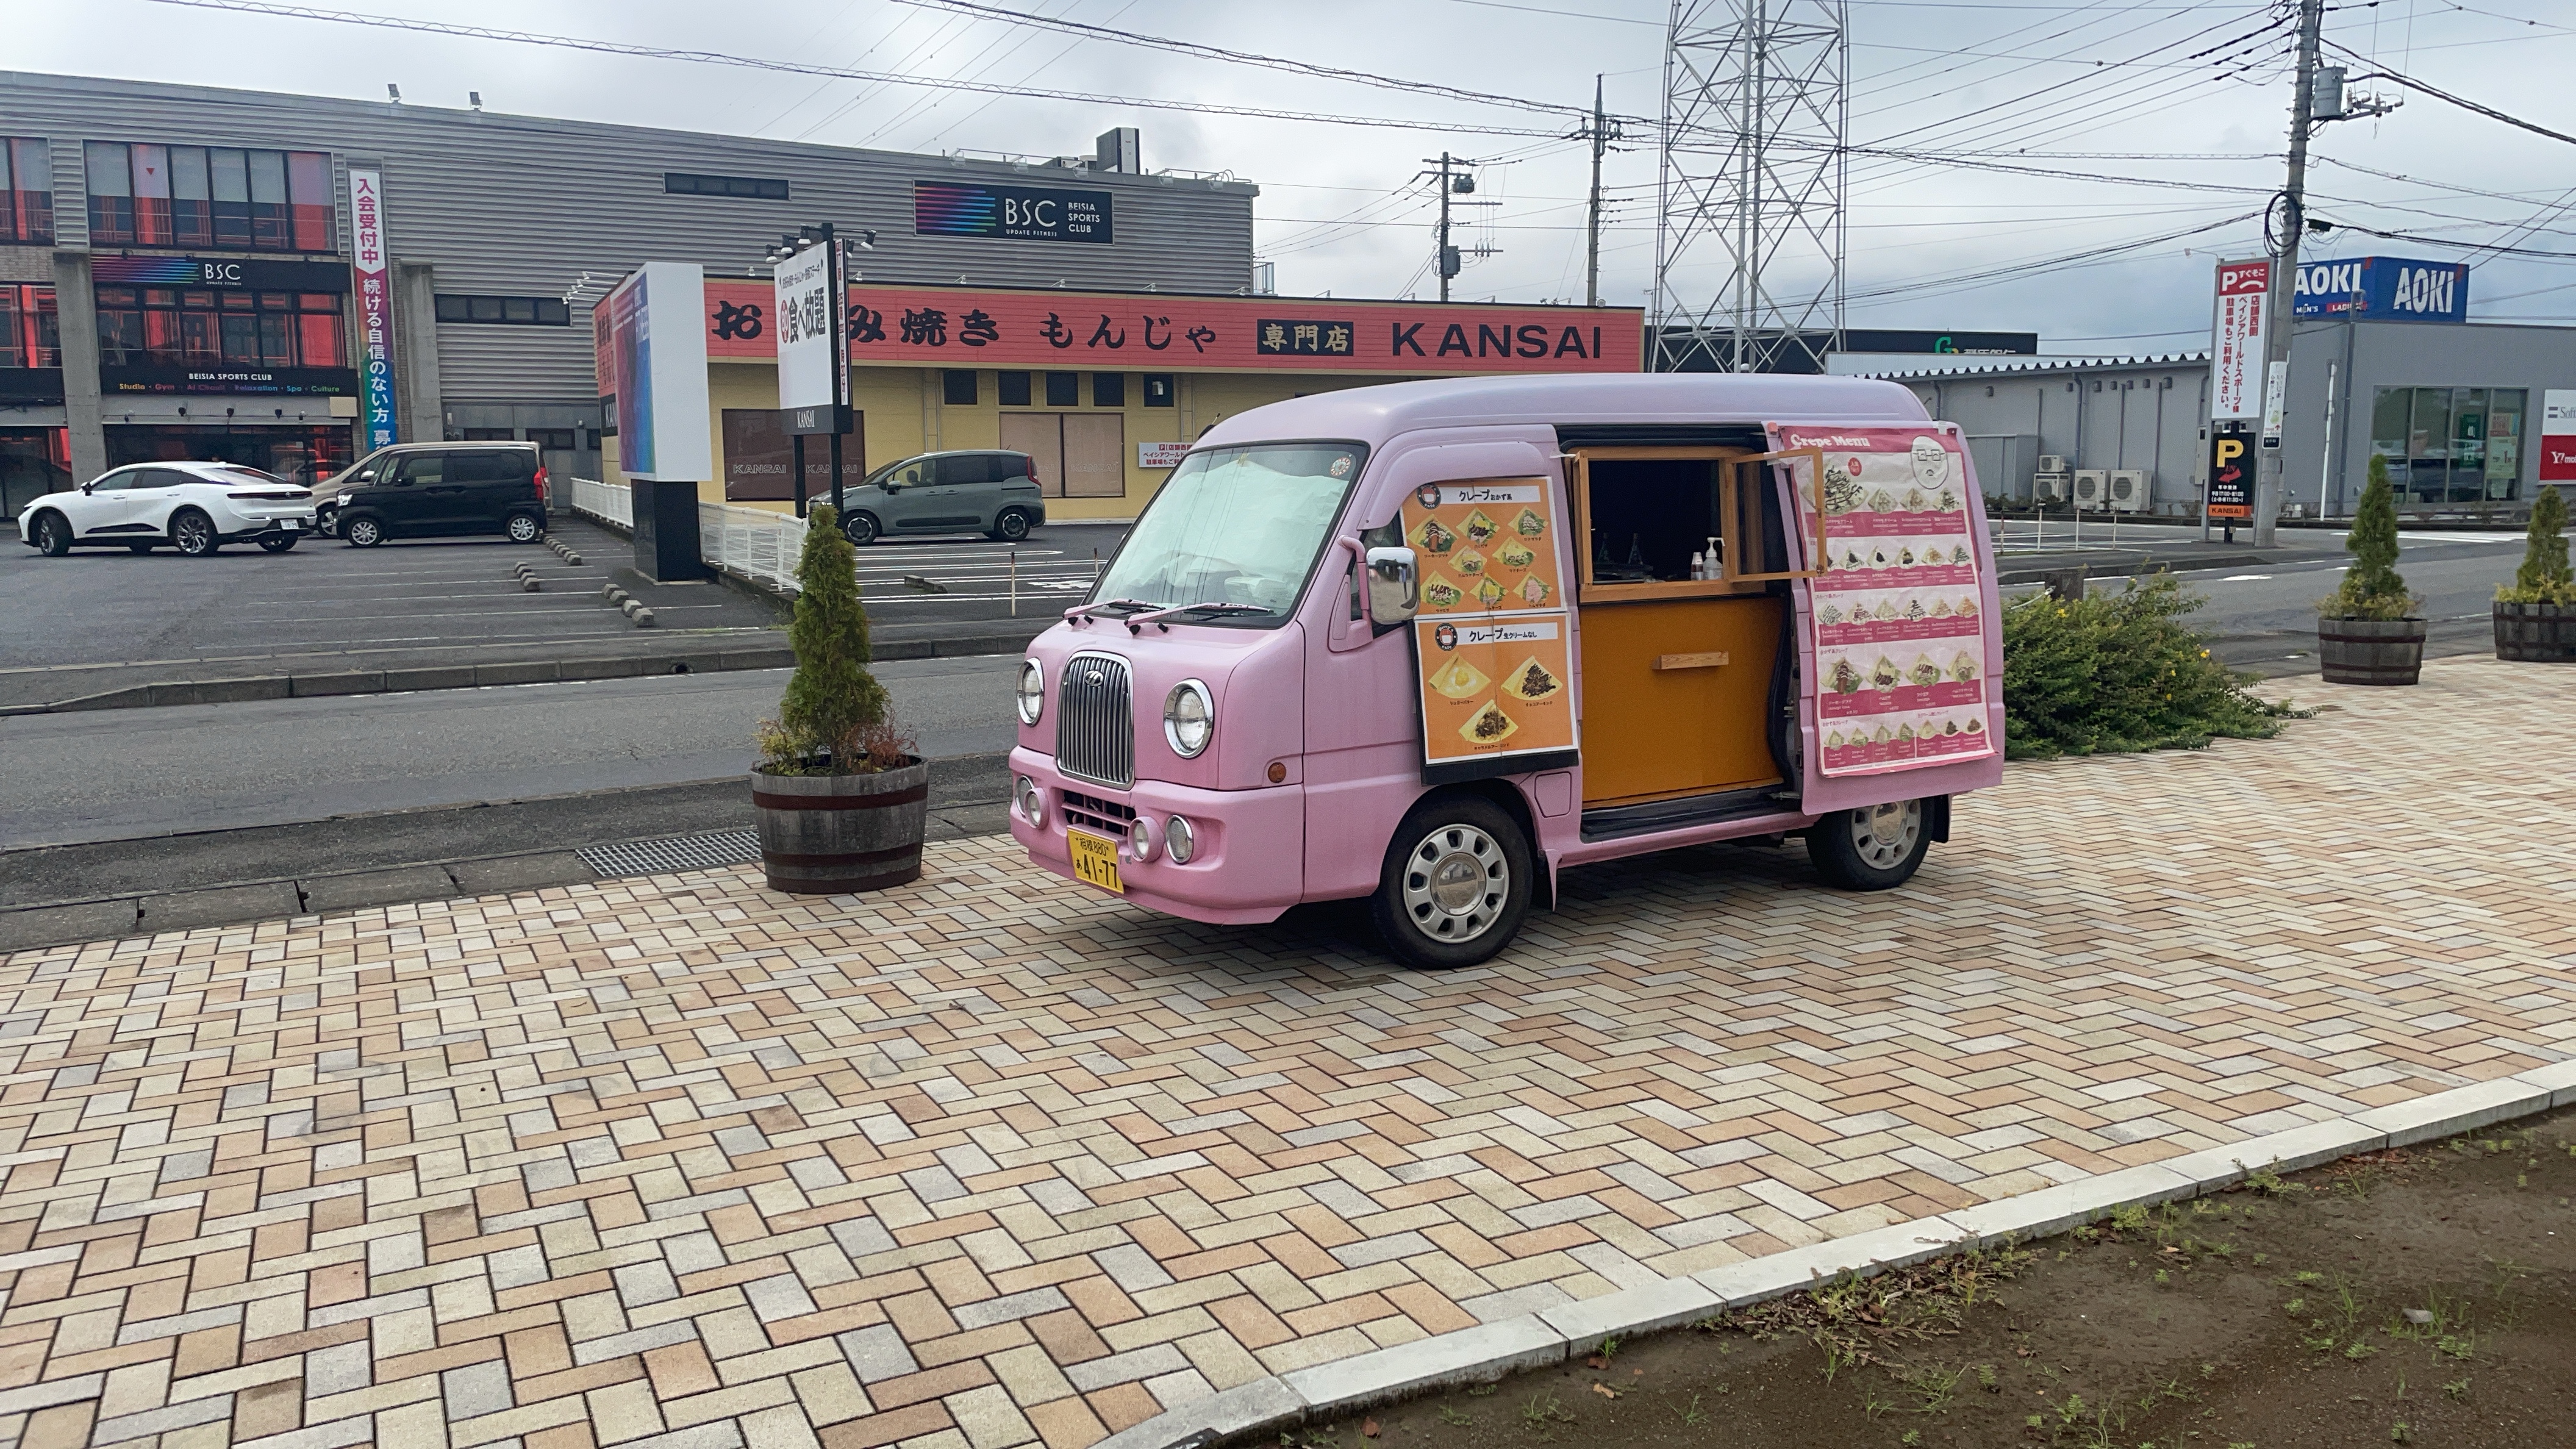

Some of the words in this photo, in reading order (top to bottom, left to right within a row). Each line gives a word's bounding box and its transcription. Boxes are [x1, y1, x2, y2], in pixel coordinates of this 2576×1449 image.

[1005, 198, 1056, 227] BSC
[1068, 202, 1096, 212] BEISIA
[1068, 213, 1100, 223] SPORTS
[357, 177, 379, 265] 入会受付中
[1068, 224, 1092, 233] CLUB
[205, 263, 241, 280] BSC
[2222, 271, 2238, 292] P
[2238, 269, 2265, 279] すぐそこ
[2294, 263, 2361, 296] AOKI
[2393, 267, 2455, 314] AOKI
[711, 300, 999, 348] おみ焼き
[1039, 312, 1217, 353] もんじゃ
[789, 286, 826, 344] 食べ放題
[363, 278, 389, 423] 続ける自信のない方
[1261, 323, 1350, 353] 専門店
[1392, 323, 1601, 359] KANSAI
[287, 385, 302, 393] Spa
[796, 410, 815, 428] KANSAI
[1790, 434, 1832, 448] Crepe
[1831, 435, 1870, 447] Menu
[2216, 439, 2244, 468] P
[733, 464, 787, 474] KANSAI
[1459, 488, 1490, 501] クレープ
[1469, 628, 1504, 642] クレープ
[1076, 857, 1082, 870] あ
[1084, 854, 1118, 889] 41-77
